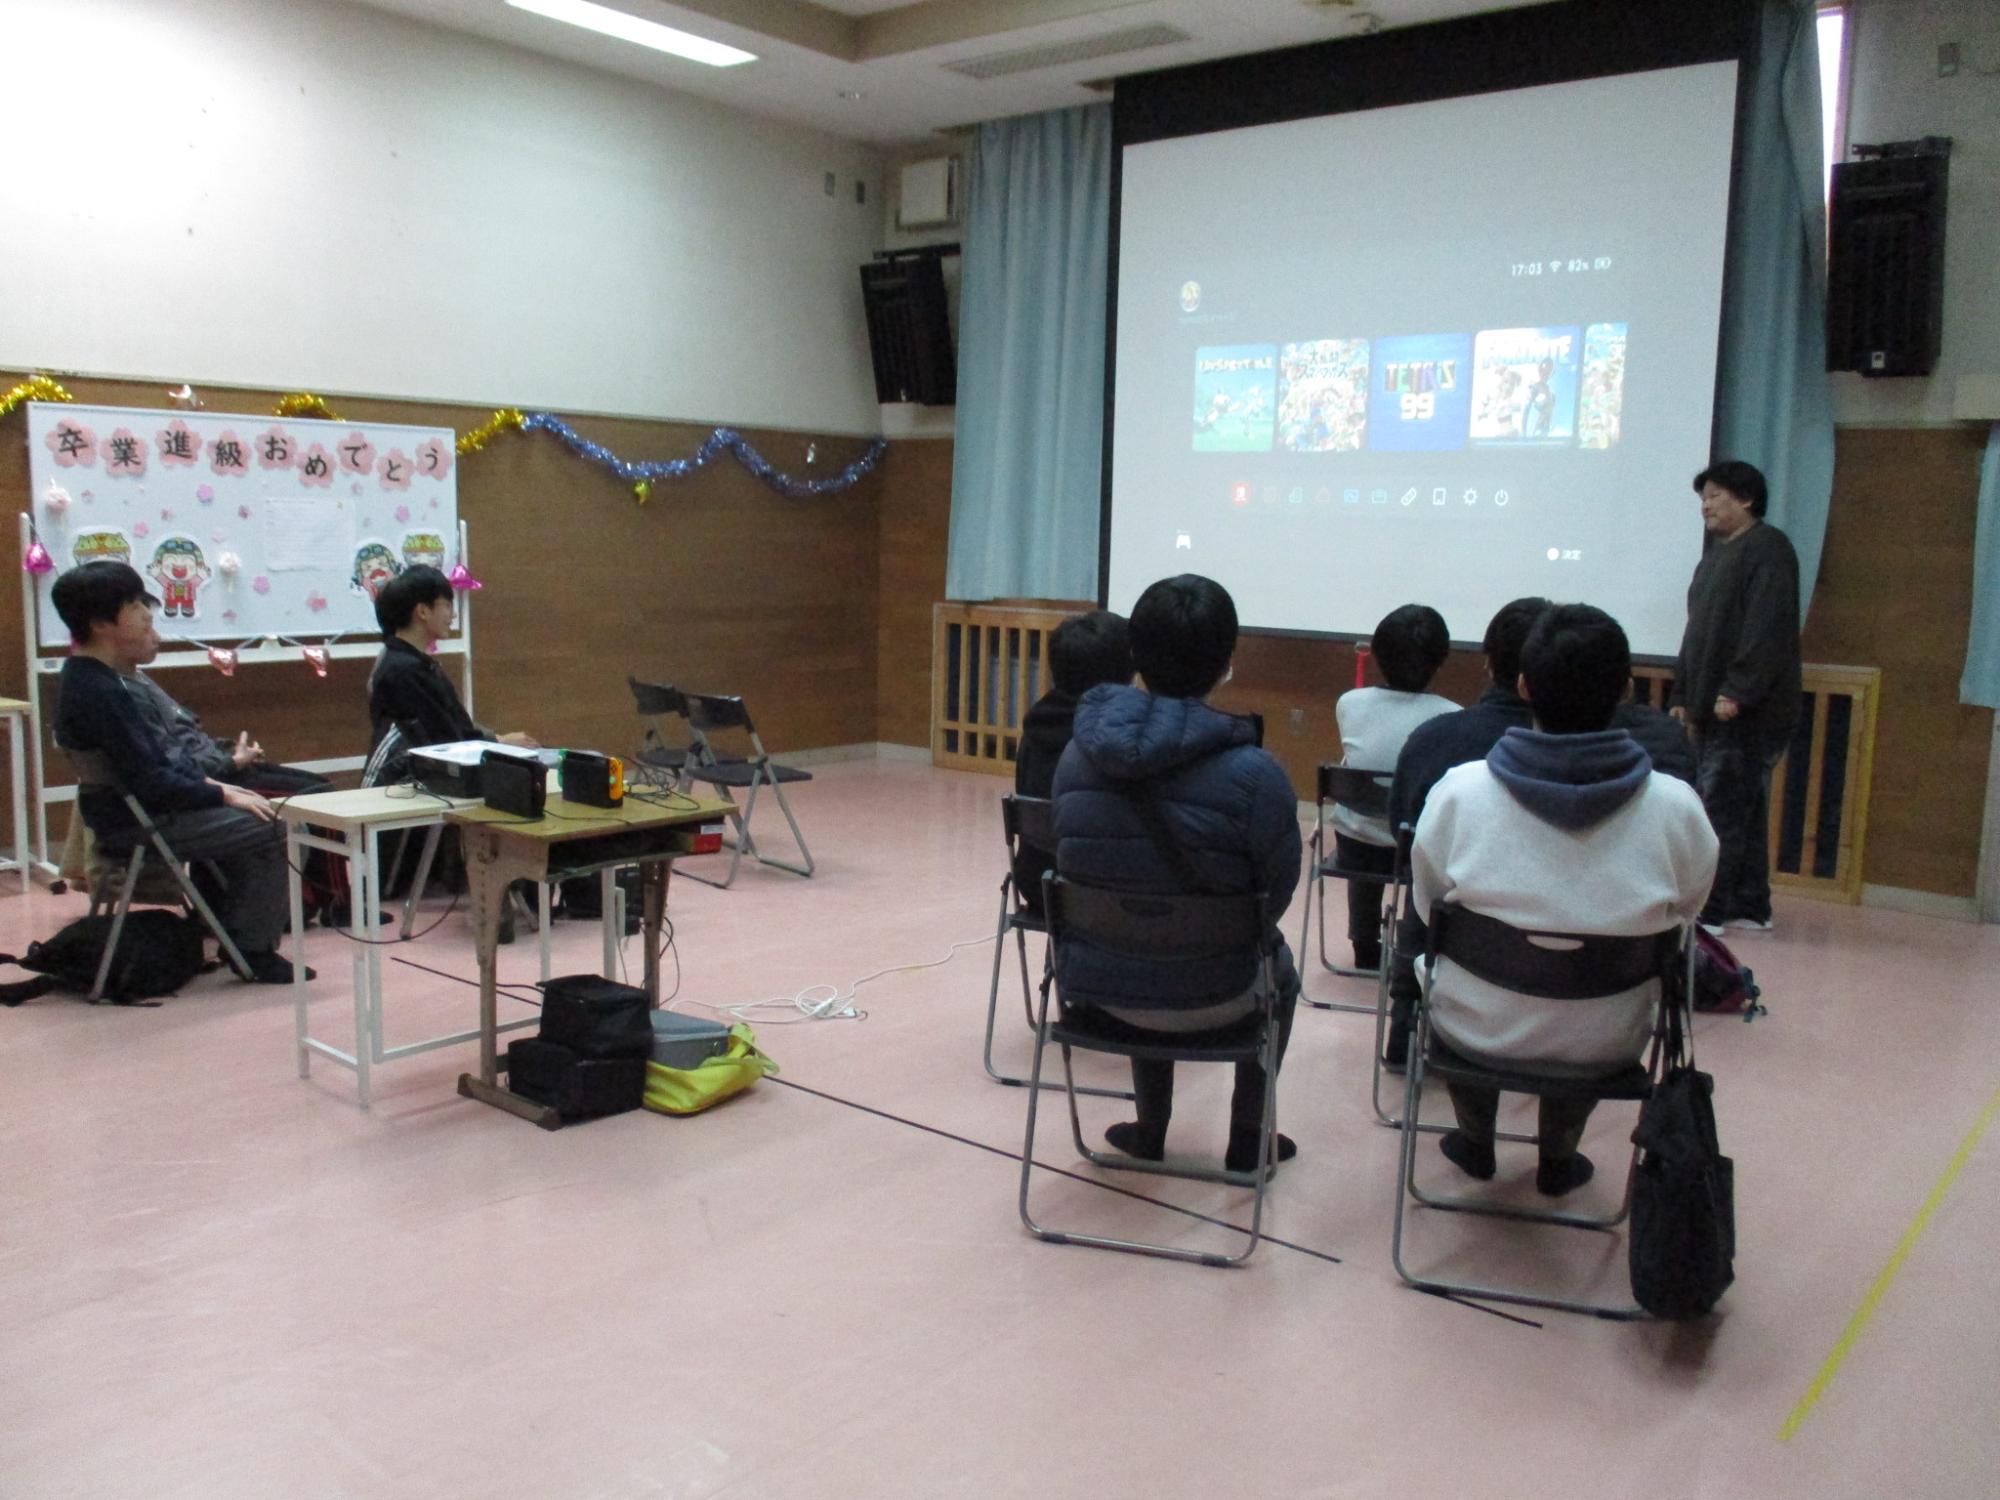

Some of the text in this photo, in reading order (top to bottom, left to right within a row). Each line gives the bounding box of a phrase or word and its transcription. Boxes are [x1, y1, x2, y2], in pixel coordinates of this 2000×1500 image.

[1512, 262, 1542, 277] 17:03
[1384, 361, 1456, 393] TETRIS
[1400, 391, 1434, 420] 99
[57, 427, 440, 483] 卒業進級おめでとう
